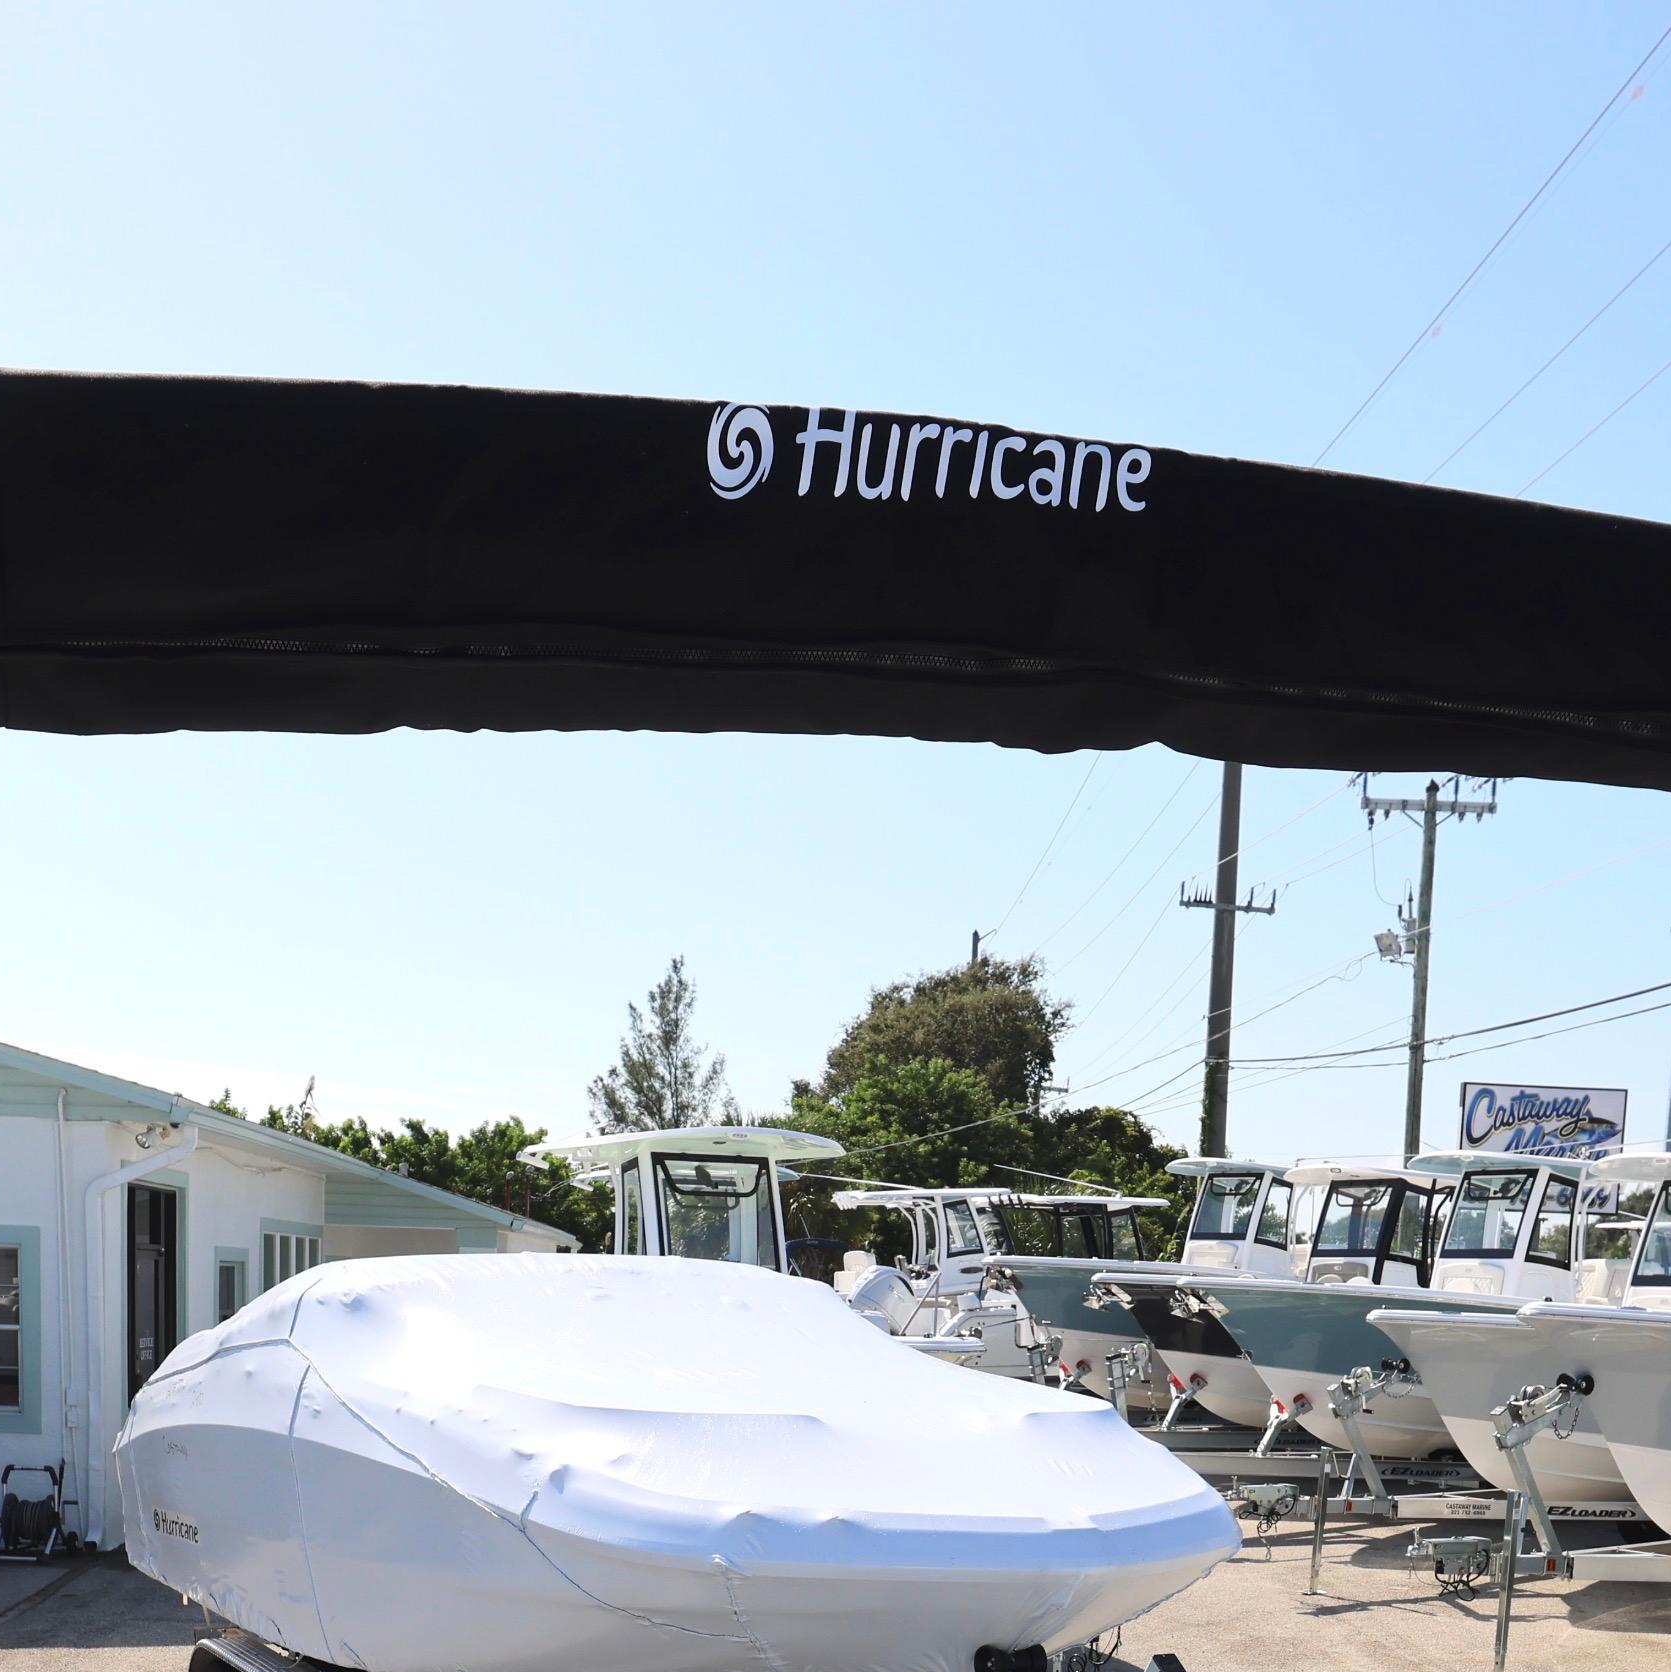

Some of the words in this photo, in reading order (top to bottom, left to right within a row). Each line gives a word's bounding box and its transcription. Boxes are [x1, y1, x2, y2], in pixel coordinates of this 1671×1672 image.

[797, 408, 1153, 513] Hurricane
[1465, 1087, 1591, 1146] Castaway
[161, 1509, 199, 1544] Hurricane
[1547, 1505, 1627, 1519] EZLOADER
